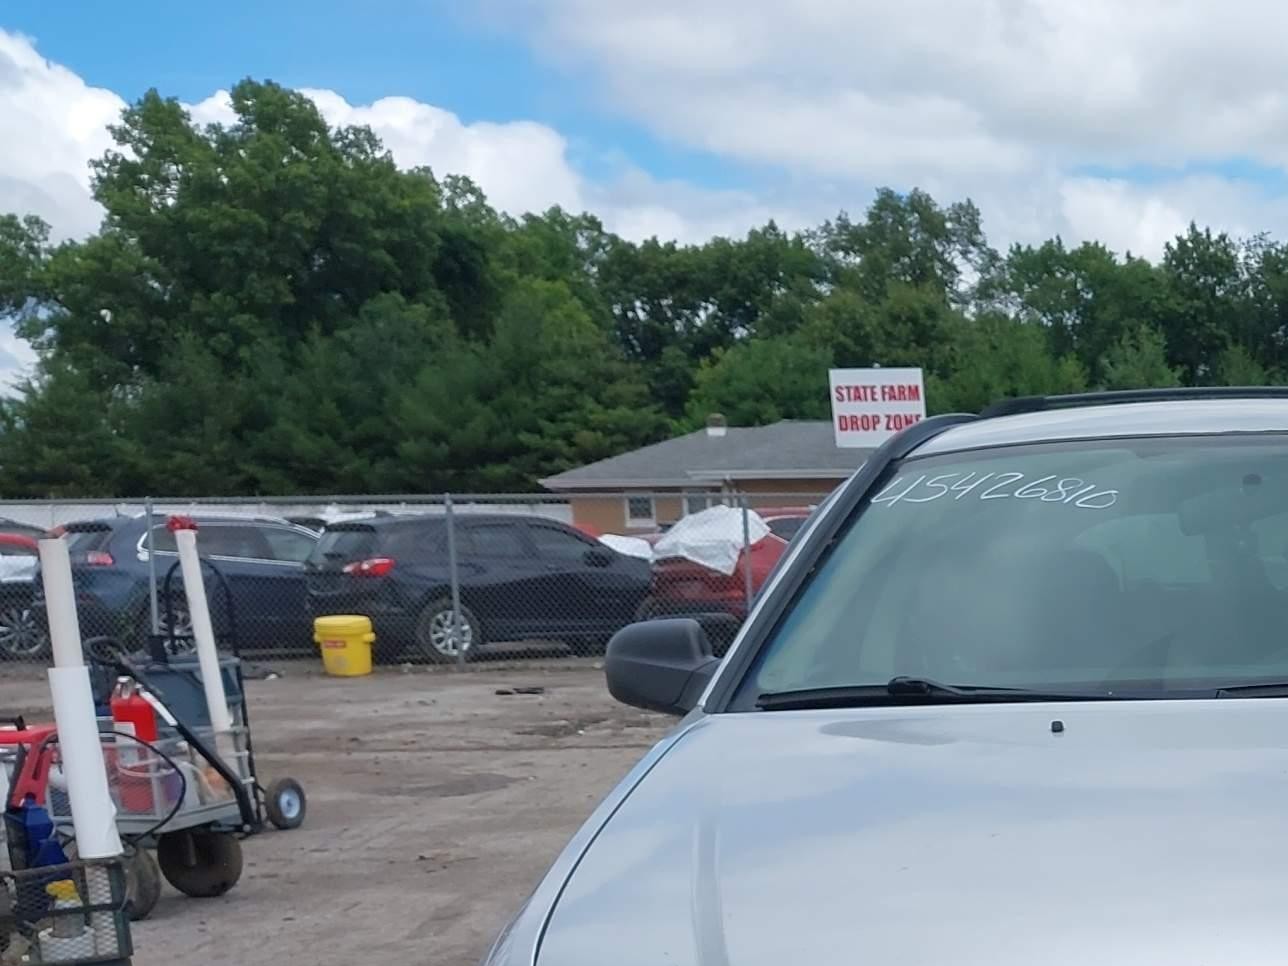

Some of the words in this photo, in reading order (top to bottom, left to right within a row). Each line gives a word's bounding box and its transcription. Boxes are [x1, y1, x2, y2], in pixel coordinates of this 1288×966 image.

[835, 385, 877, 402] STATE
[881, 385, 921, 402] FARM
[838, 415, 880, 432] DROP
[871, 472, 1119, 509] 45426810
